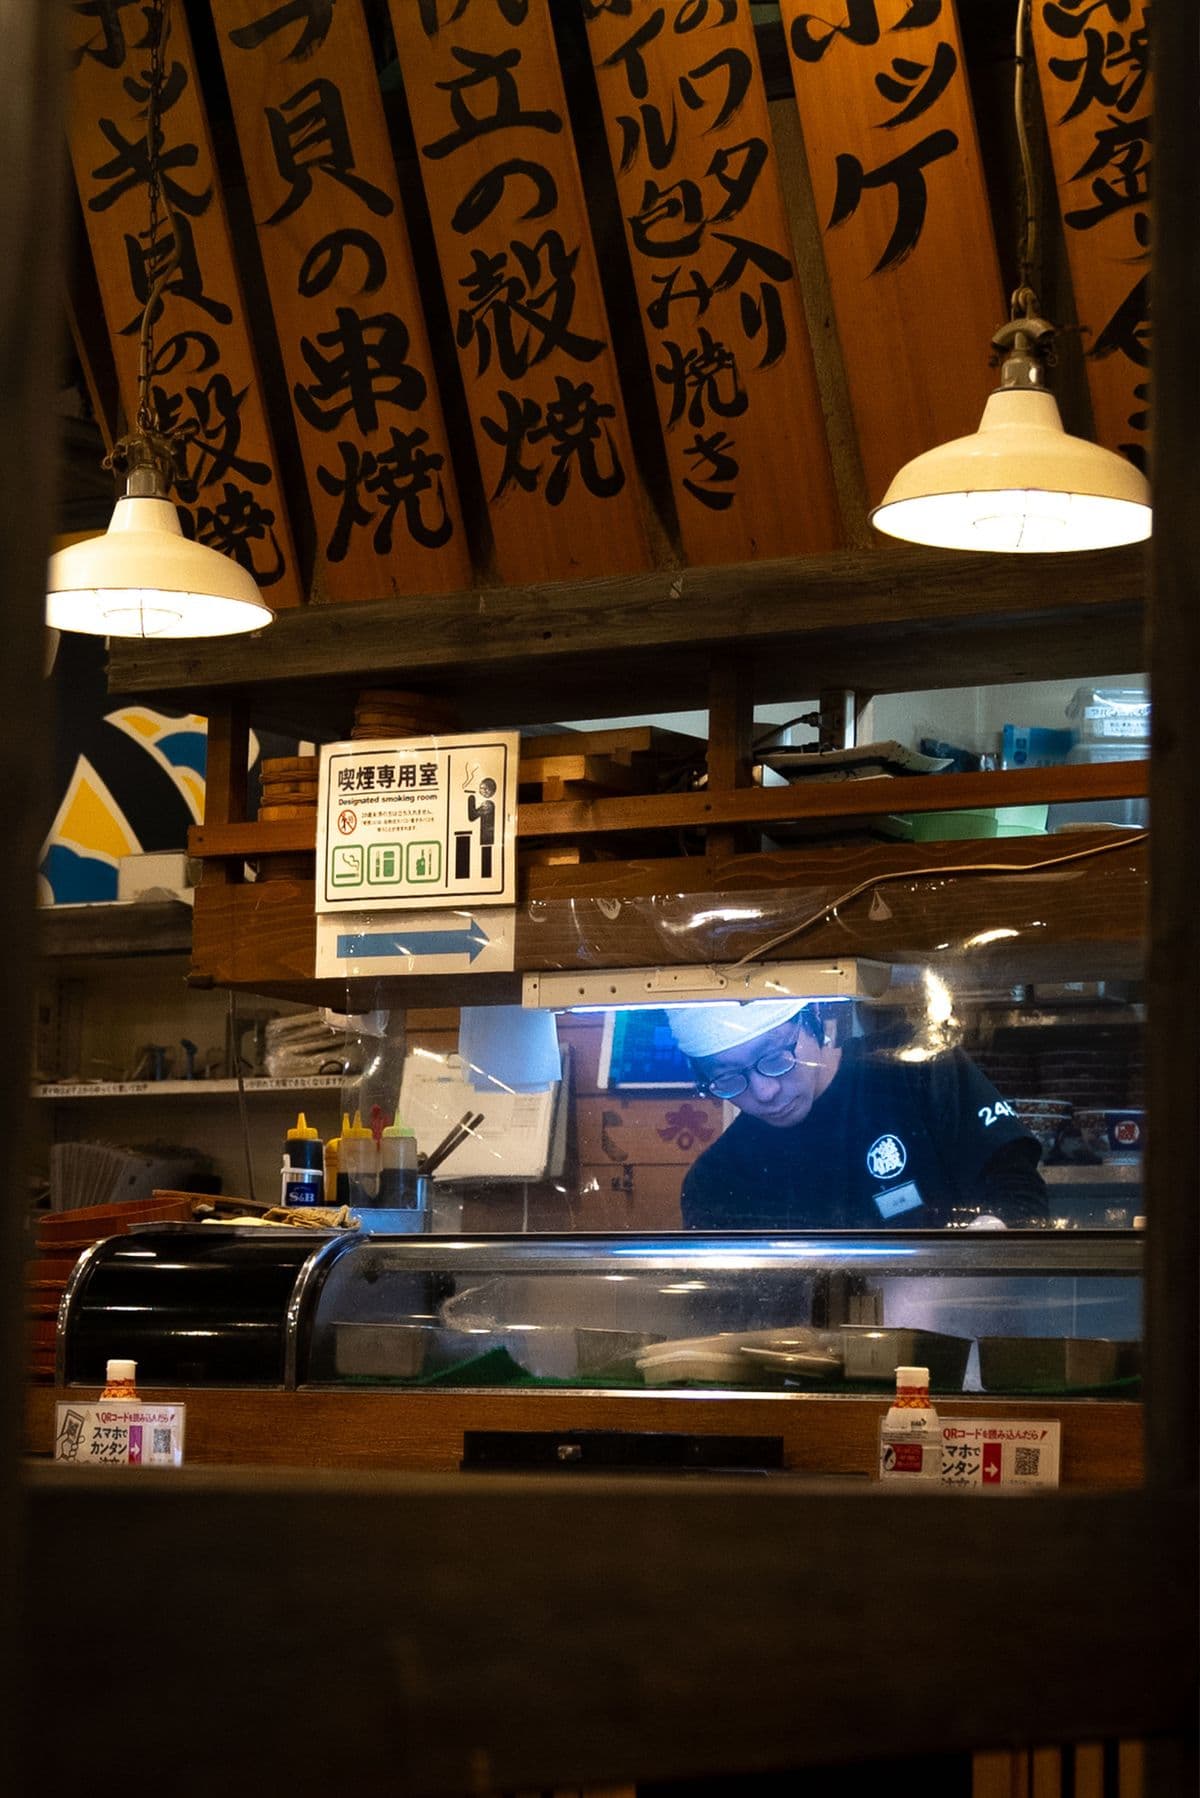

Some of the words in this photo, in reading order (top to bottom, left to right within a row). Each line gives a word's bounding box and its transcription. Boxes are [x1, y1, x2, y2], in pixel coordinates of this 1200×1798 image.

[583, 0, 749, 511] イル包み焼き
[338, 762, 439, 791] 喫煙専用室
[338, 796, 380, 806] Designated
[382, 794, 415, 803] smoking
[417, 793, 438, 801] room
[289, 1191, 315, 1202] S&B
[92, 1426, 128, 1440] スマホで
[90, 1441, 128, 1455] カンタン
[941, 1444, 980, 1459] マホで
[941, 1461, 980, 1476] ンタン
